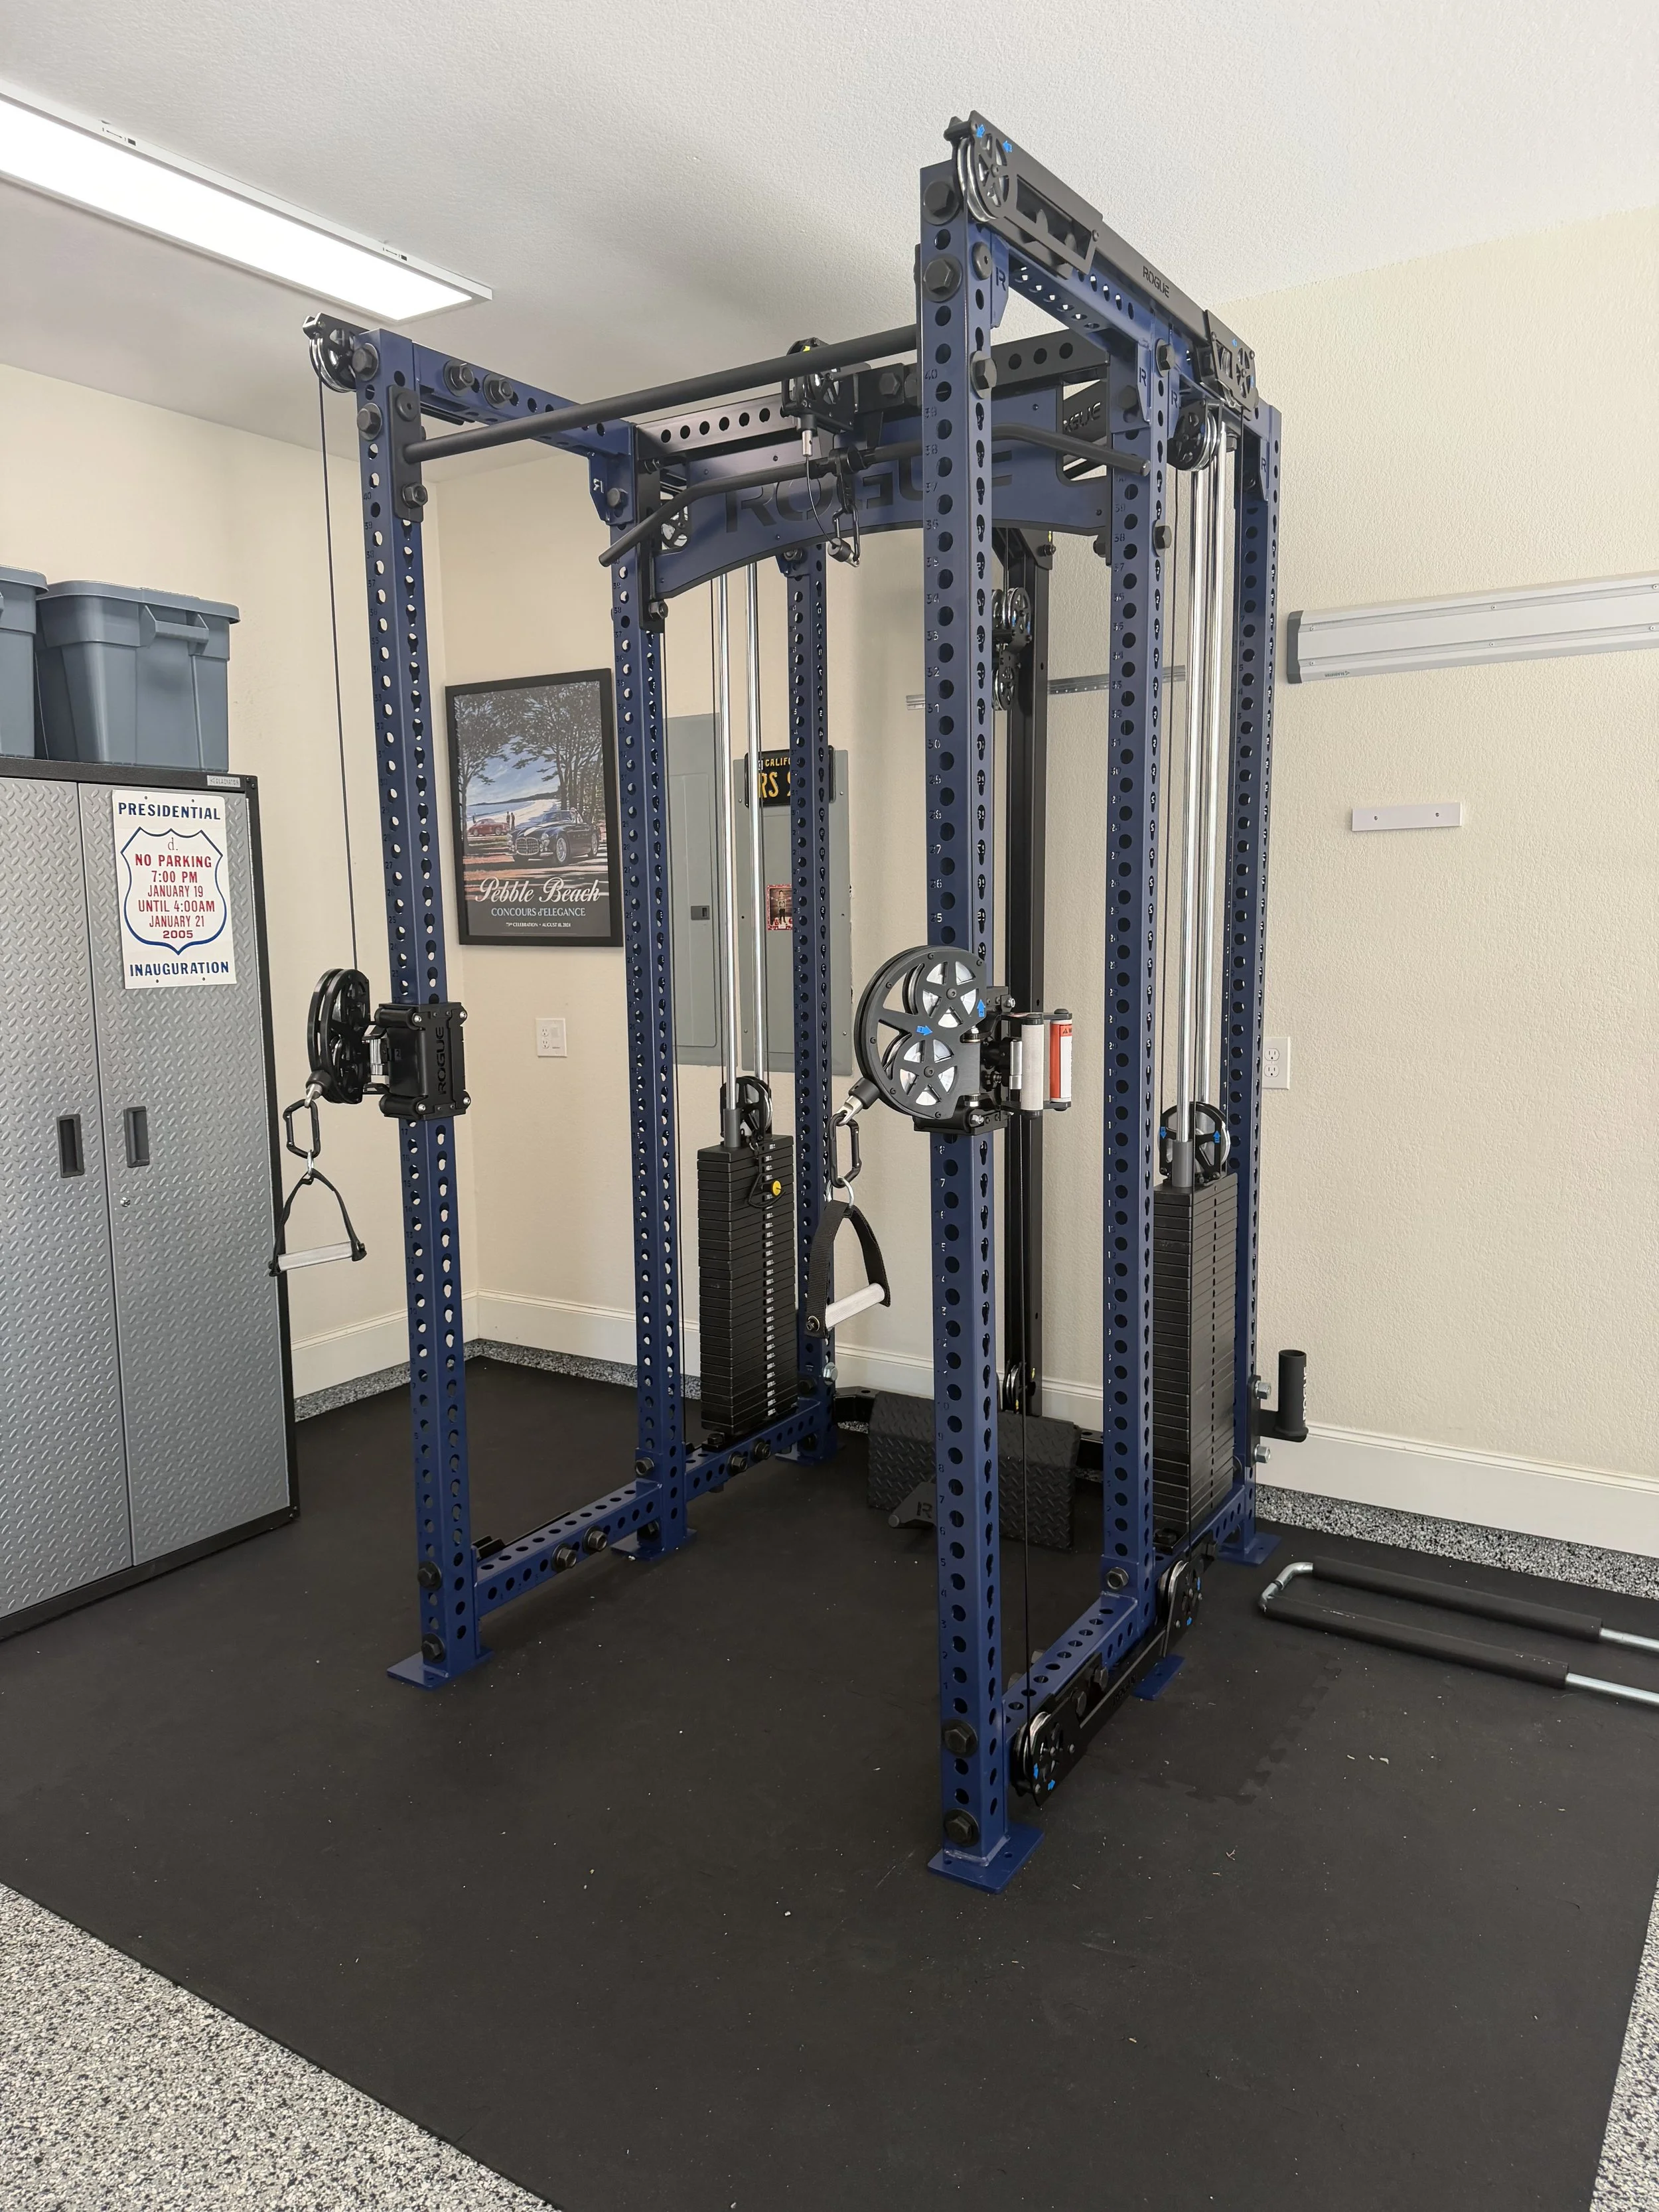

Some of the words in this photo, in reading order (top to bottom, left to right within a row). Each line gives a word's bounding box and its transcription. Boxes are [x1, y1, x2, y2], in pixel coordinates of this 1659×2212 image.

[1142, 265, 1170, 299] ROGUE
[368, 579, 376, 587] 37
[927, 667, 940, 678] 32
[927, 703, 940, 713] 31
[118, 802, 221, 820] PRESIDENTIAL
[929, 844, 941, 854] 27
[135, 853, 151, 866] NO
[158, 854, 212, 867] PARKING
[1110, 851, 1119, 860] 27
[151, 870, 176, 883] 7:00
[182, 871, 198, 883] PM
[147, 885, 190, 897] JANUARY
[194, 885, 203, 897] 19
[475, 876, 534, 903] Pebble
[539, 876, 601, 903] Beach
[138, 900, 170, 912] UNTIL
[174, 900, 215, 913] 4:00AM
[491, 907, 537, 917] CONCOURS
[1110, 907, 1119, 915] 25
[149, 915, 191, 927] JANUARY
[195, 915, 204, 927] 21
[930, 913, 942, 922] 25
[163, 930, 193, 939] 2005
[129, 961, 229, 977] INAUGURATION
[435, 1027, 447, 1095] ROGUE
[939, 1495, 944, 1503] 7
[941, 1589, 947, 1598] 4
